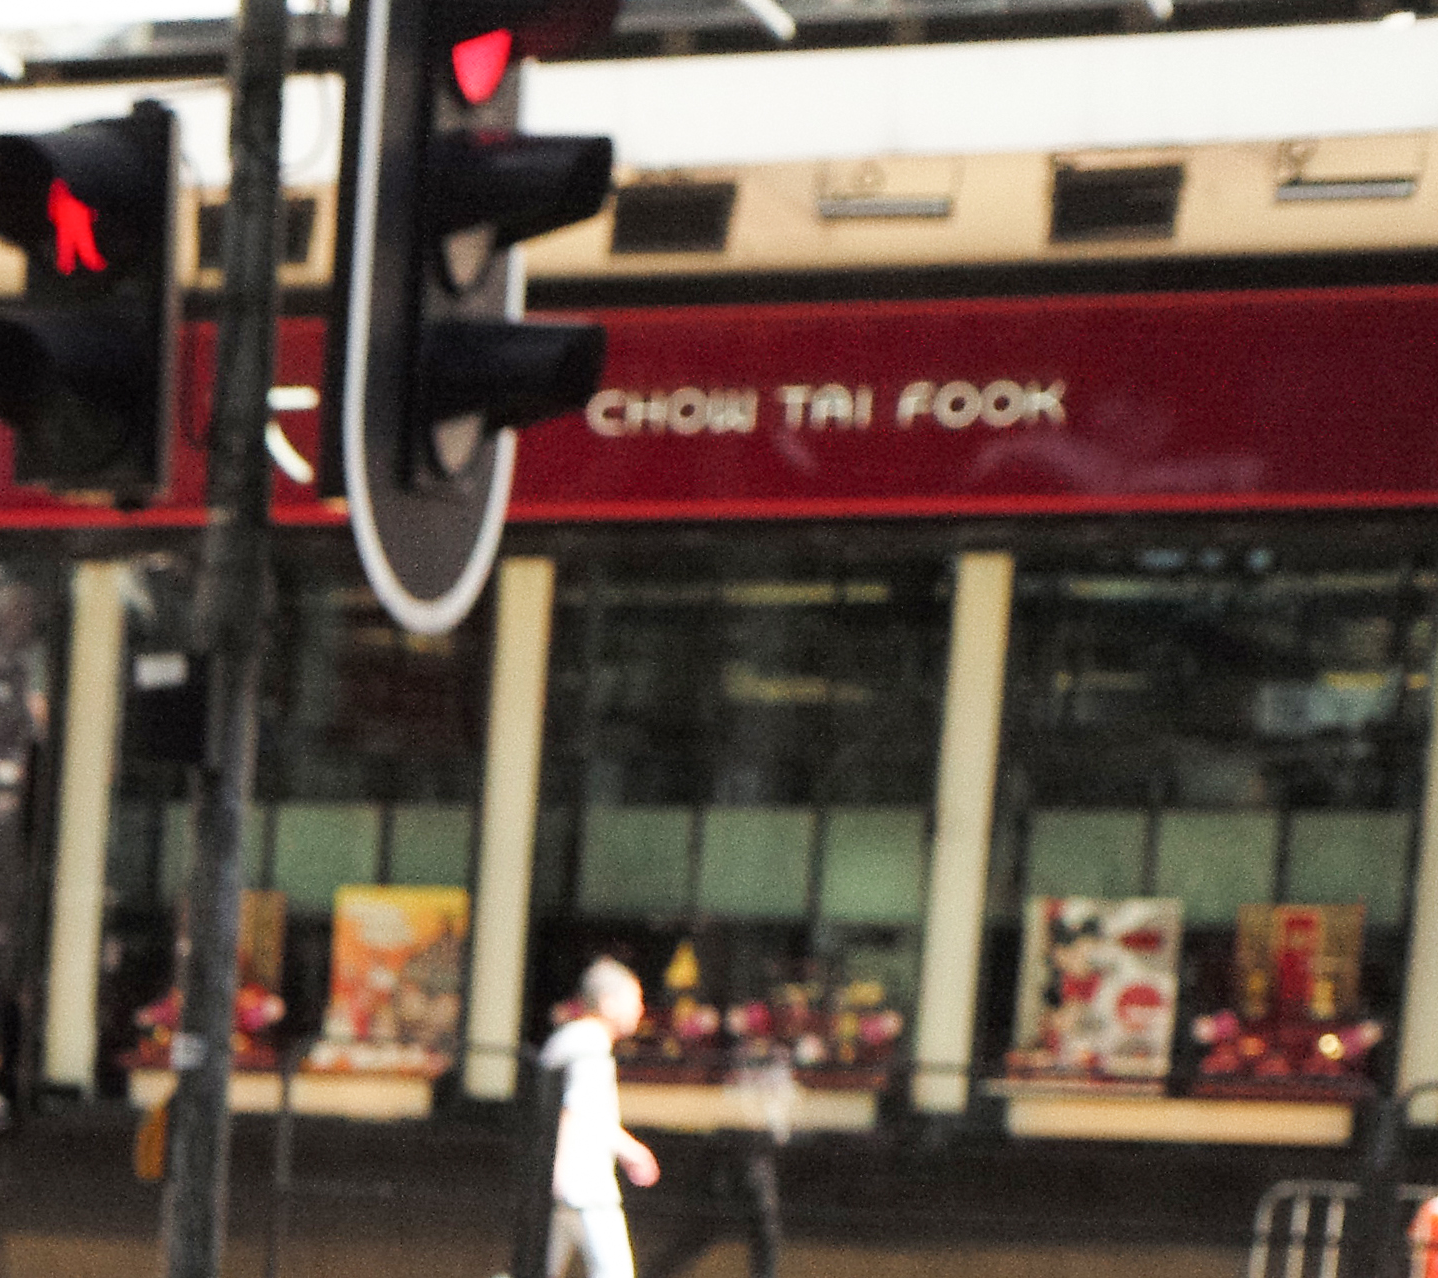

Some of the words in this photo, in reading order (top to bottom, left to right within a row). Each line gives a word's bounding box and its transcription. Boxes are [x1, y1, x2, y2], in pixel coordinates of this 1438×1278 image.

[585, 386, 759, 437] CHOW
[779, 382, 874, 432] TAI
[894, 379, 1068, 430] FOOK
